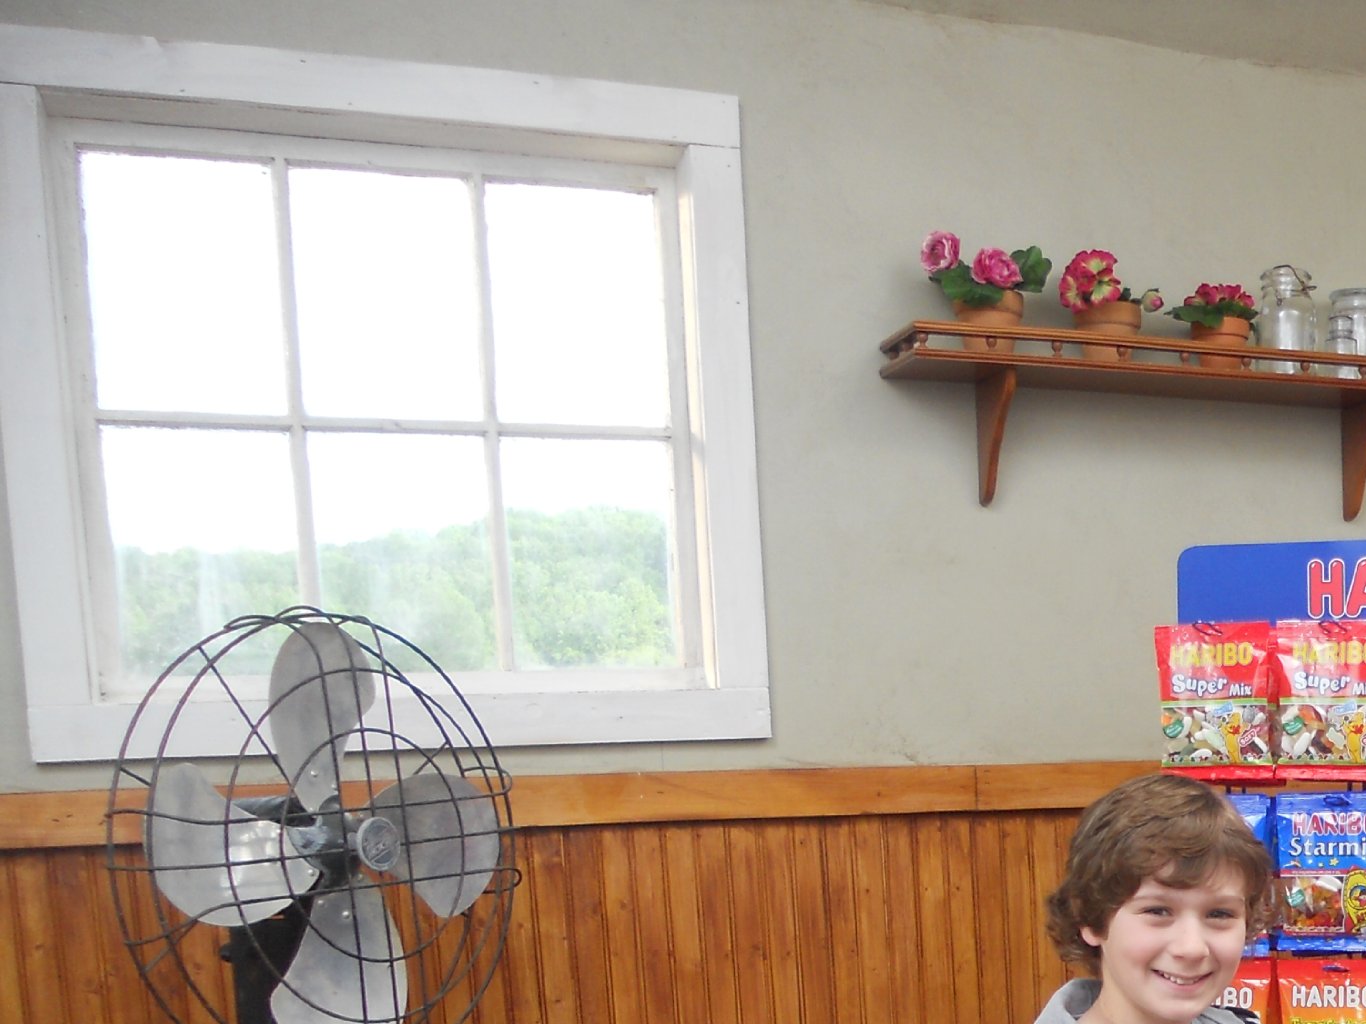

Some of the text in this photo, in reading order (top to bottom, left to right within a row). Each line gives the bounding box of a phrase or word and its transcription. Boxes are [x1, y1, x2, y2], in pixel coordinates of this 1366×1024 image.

[1170, 641, 1253, 667] HARIBO
[1171, 674, 1252, 697] Super Mix
[1294, 671, 1351, 695] Super
